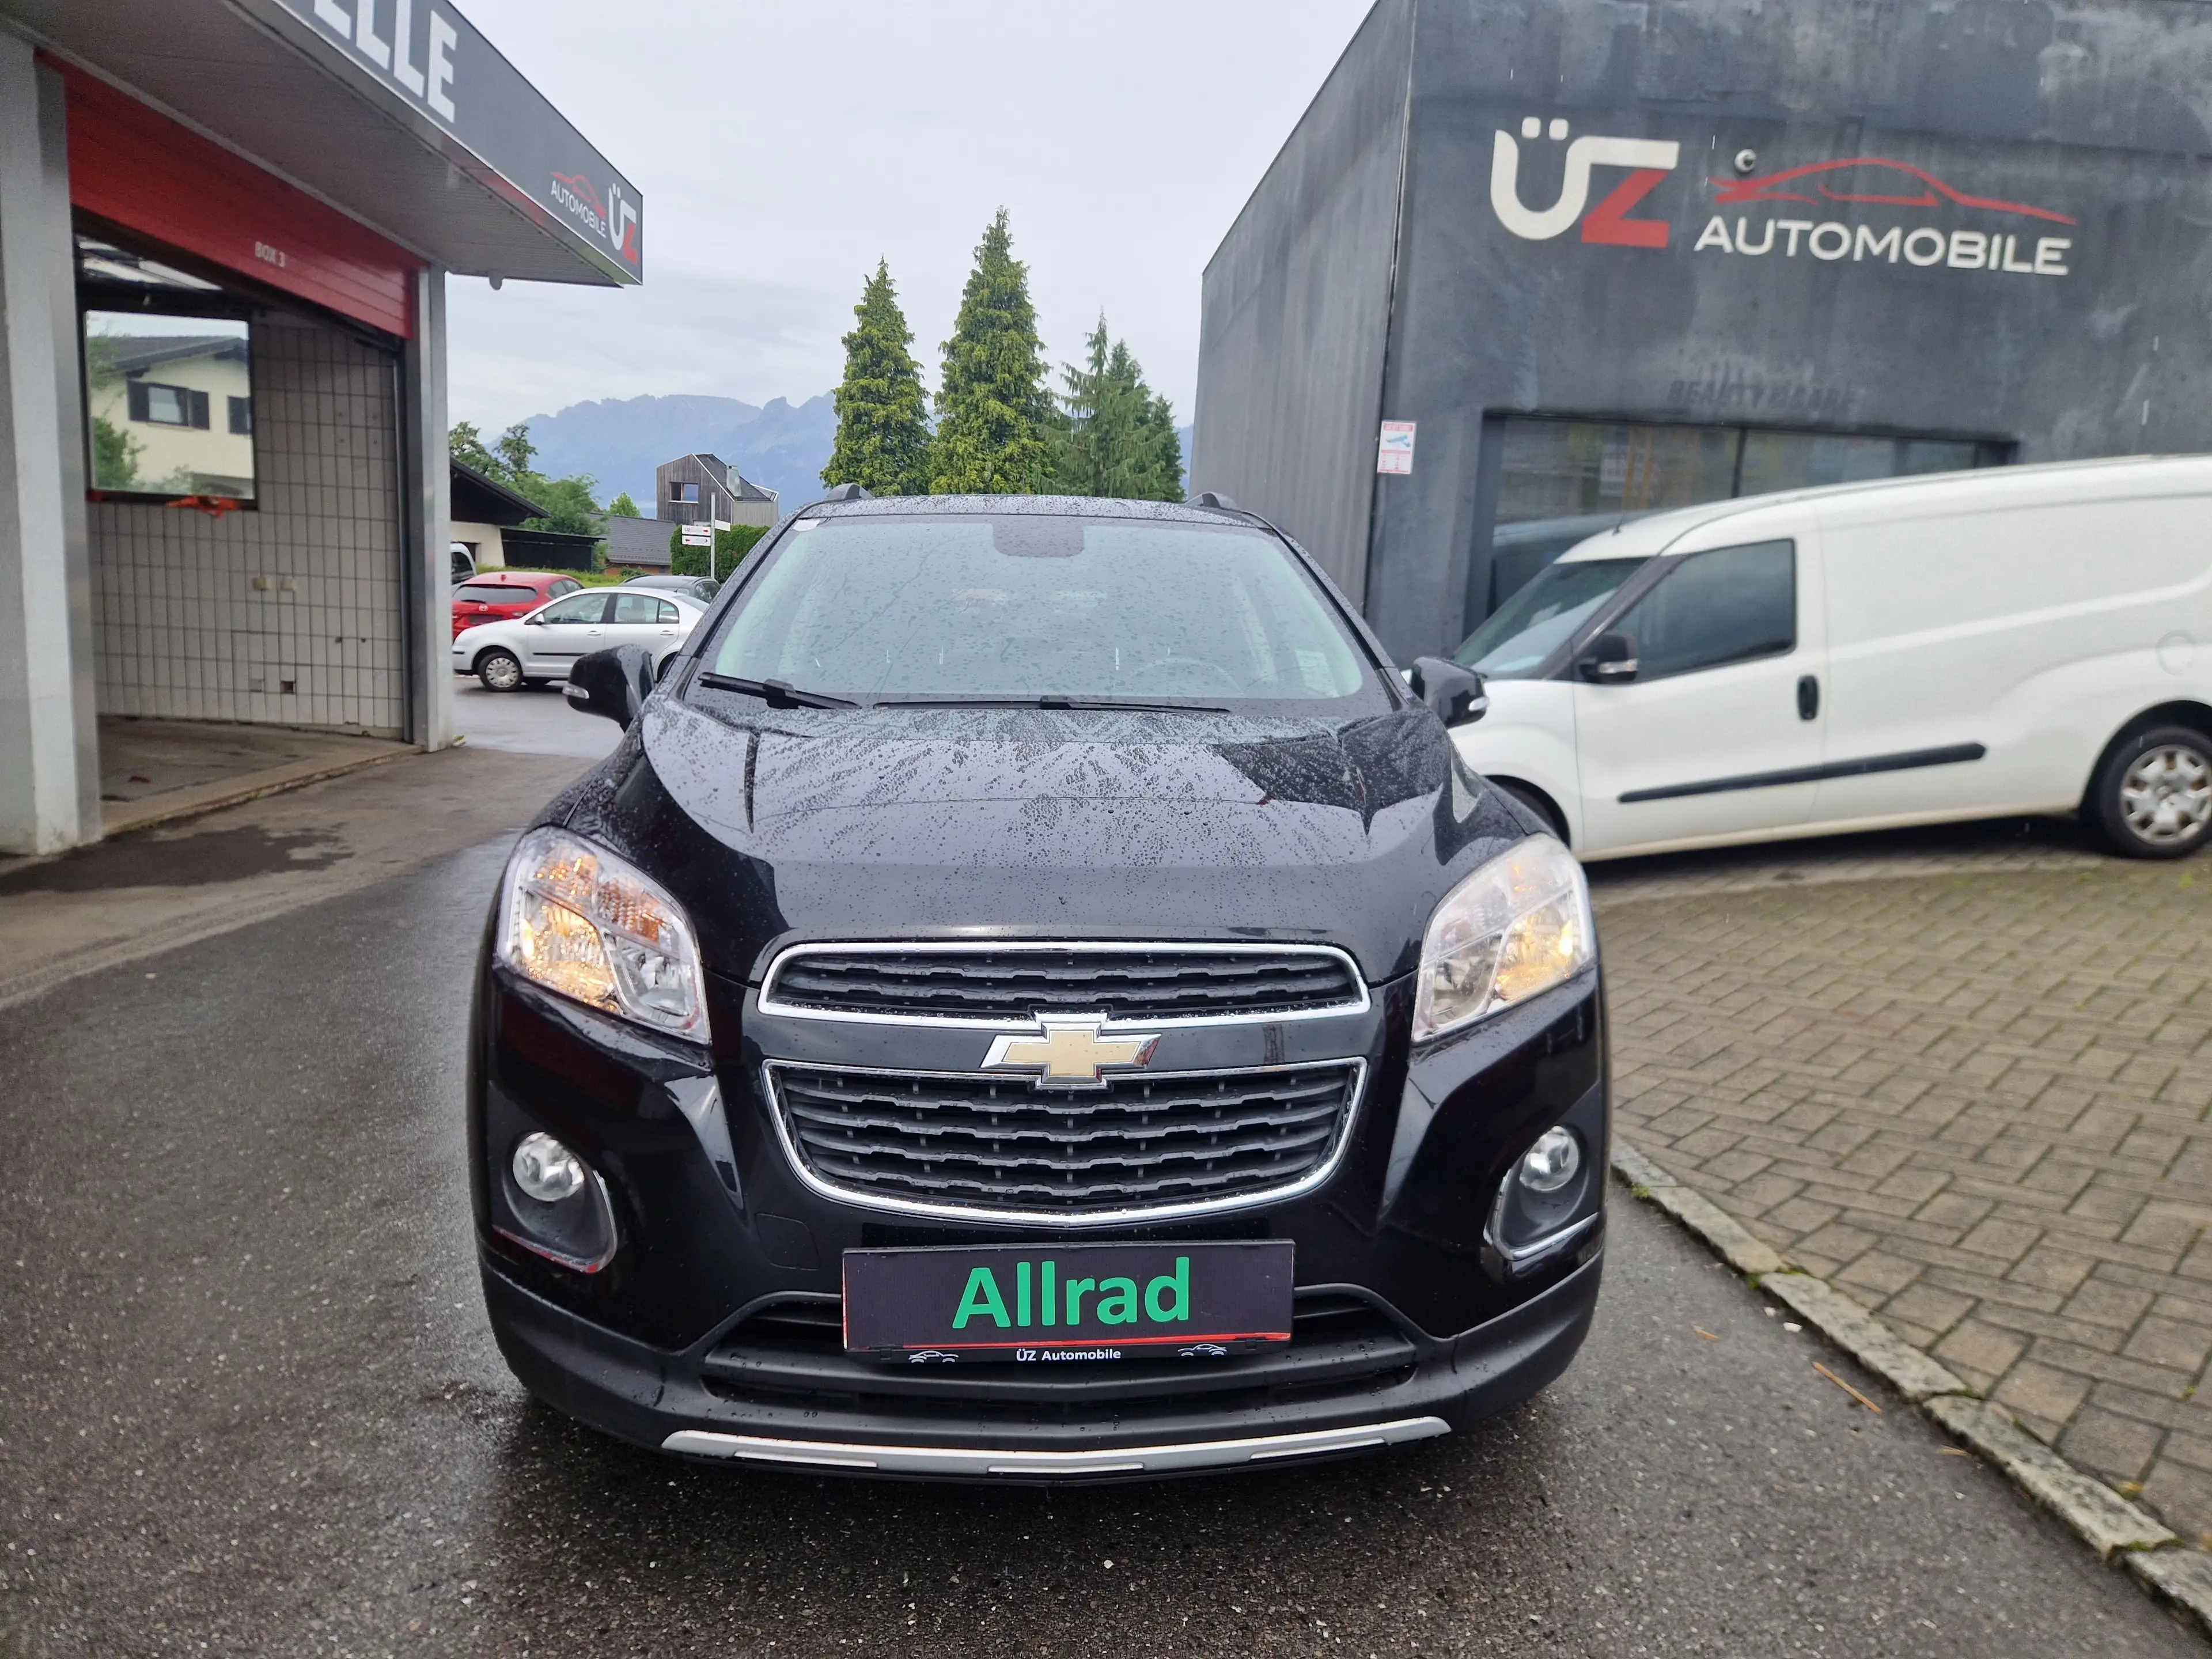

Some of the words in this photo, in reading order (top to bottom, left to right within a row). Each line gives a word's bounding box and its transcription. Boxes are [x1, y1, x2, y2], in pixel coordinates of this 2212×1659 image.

[551, 180, 607, 238] AUTOMOBILE
[255, 241, 276, 264] BOX
[1694, 215, 2072, 276] AUTOMOBILE
[952, 1256, 1190, 1329] Allrad
[1016, 1348, 1037, 1361] ÜZ
[1041, 1349, 1122, 1361] Automobile
